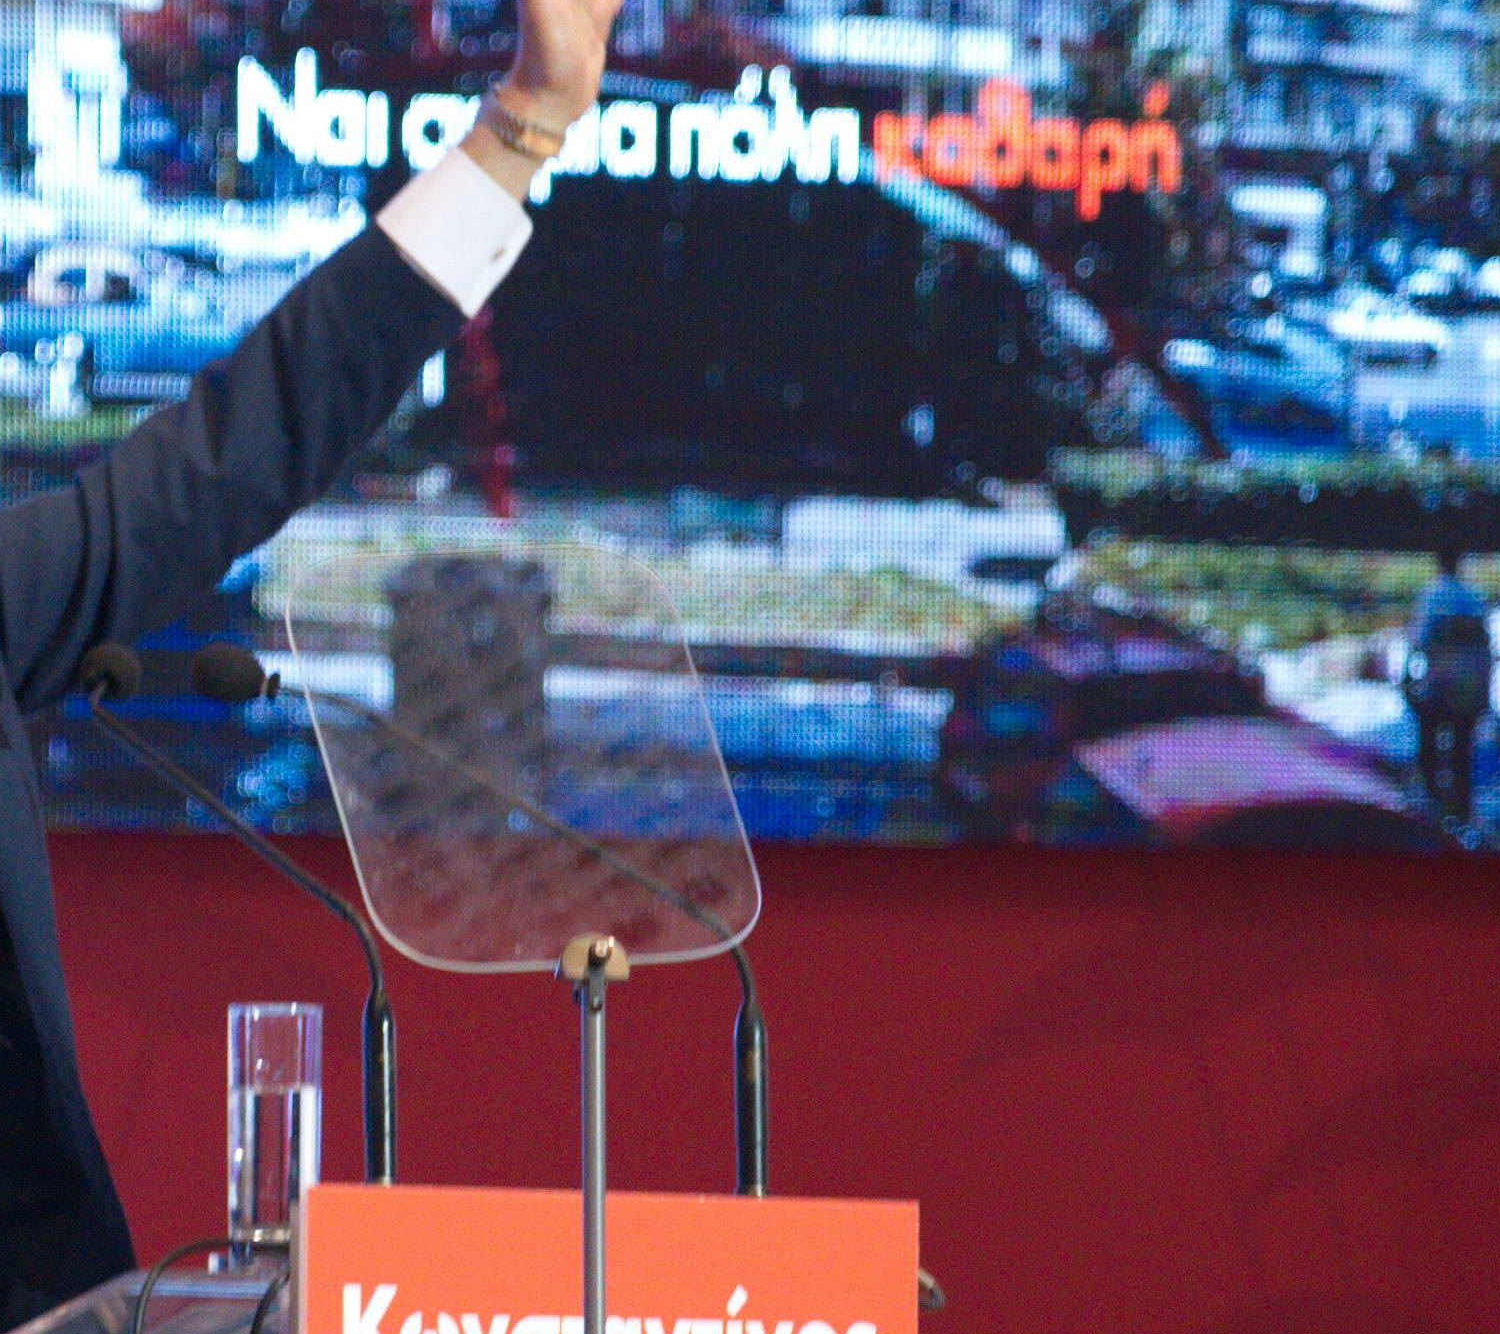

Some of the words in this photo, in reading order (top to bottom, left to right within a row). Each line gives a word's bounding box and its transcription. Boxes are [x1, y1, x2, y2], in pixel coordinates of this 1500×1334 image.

[237, 47, 389, 168] Ναι
[670, 64, 860, 184] πόλη
[873, 76, 1182, 222] καθαρή
